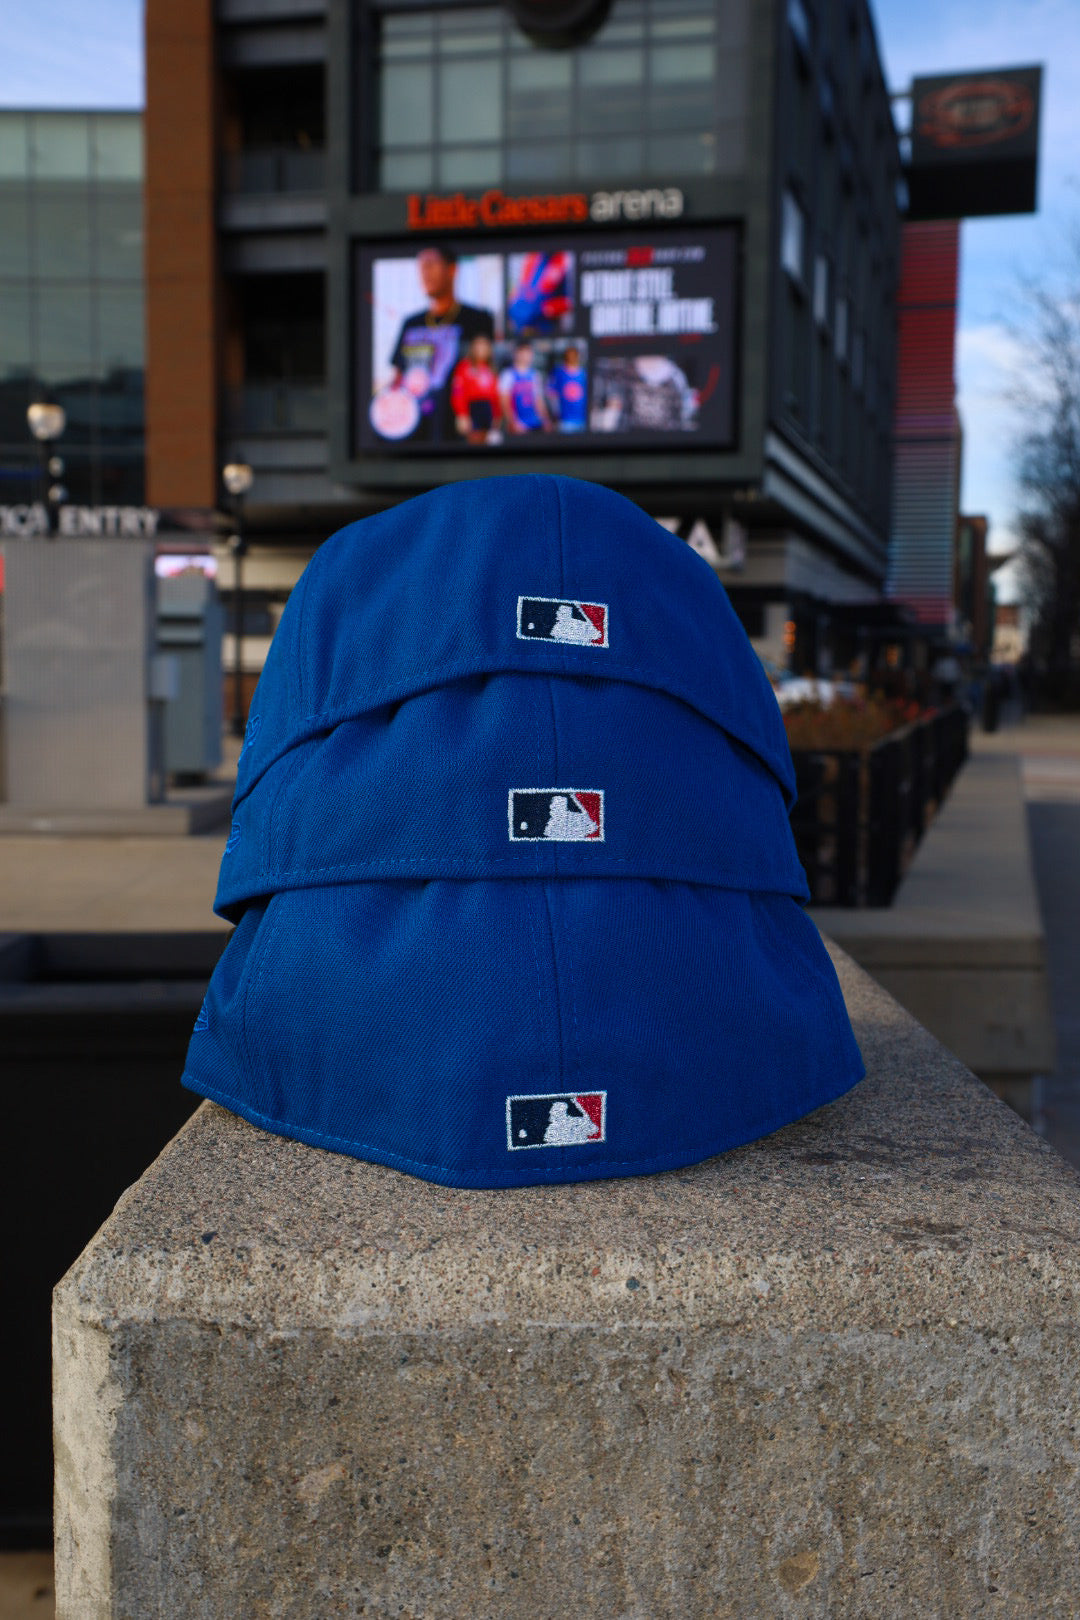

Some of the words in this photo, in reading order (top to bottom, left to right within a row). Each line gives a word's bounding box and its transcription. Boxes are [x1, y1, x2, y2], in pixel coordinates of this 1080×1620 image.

[407, 194, 478, 229] Little
[481, 190, 588, 226] Caesars
[590, 189, 683, 222] arena
[59, 504, 160, 537] ENTRY
